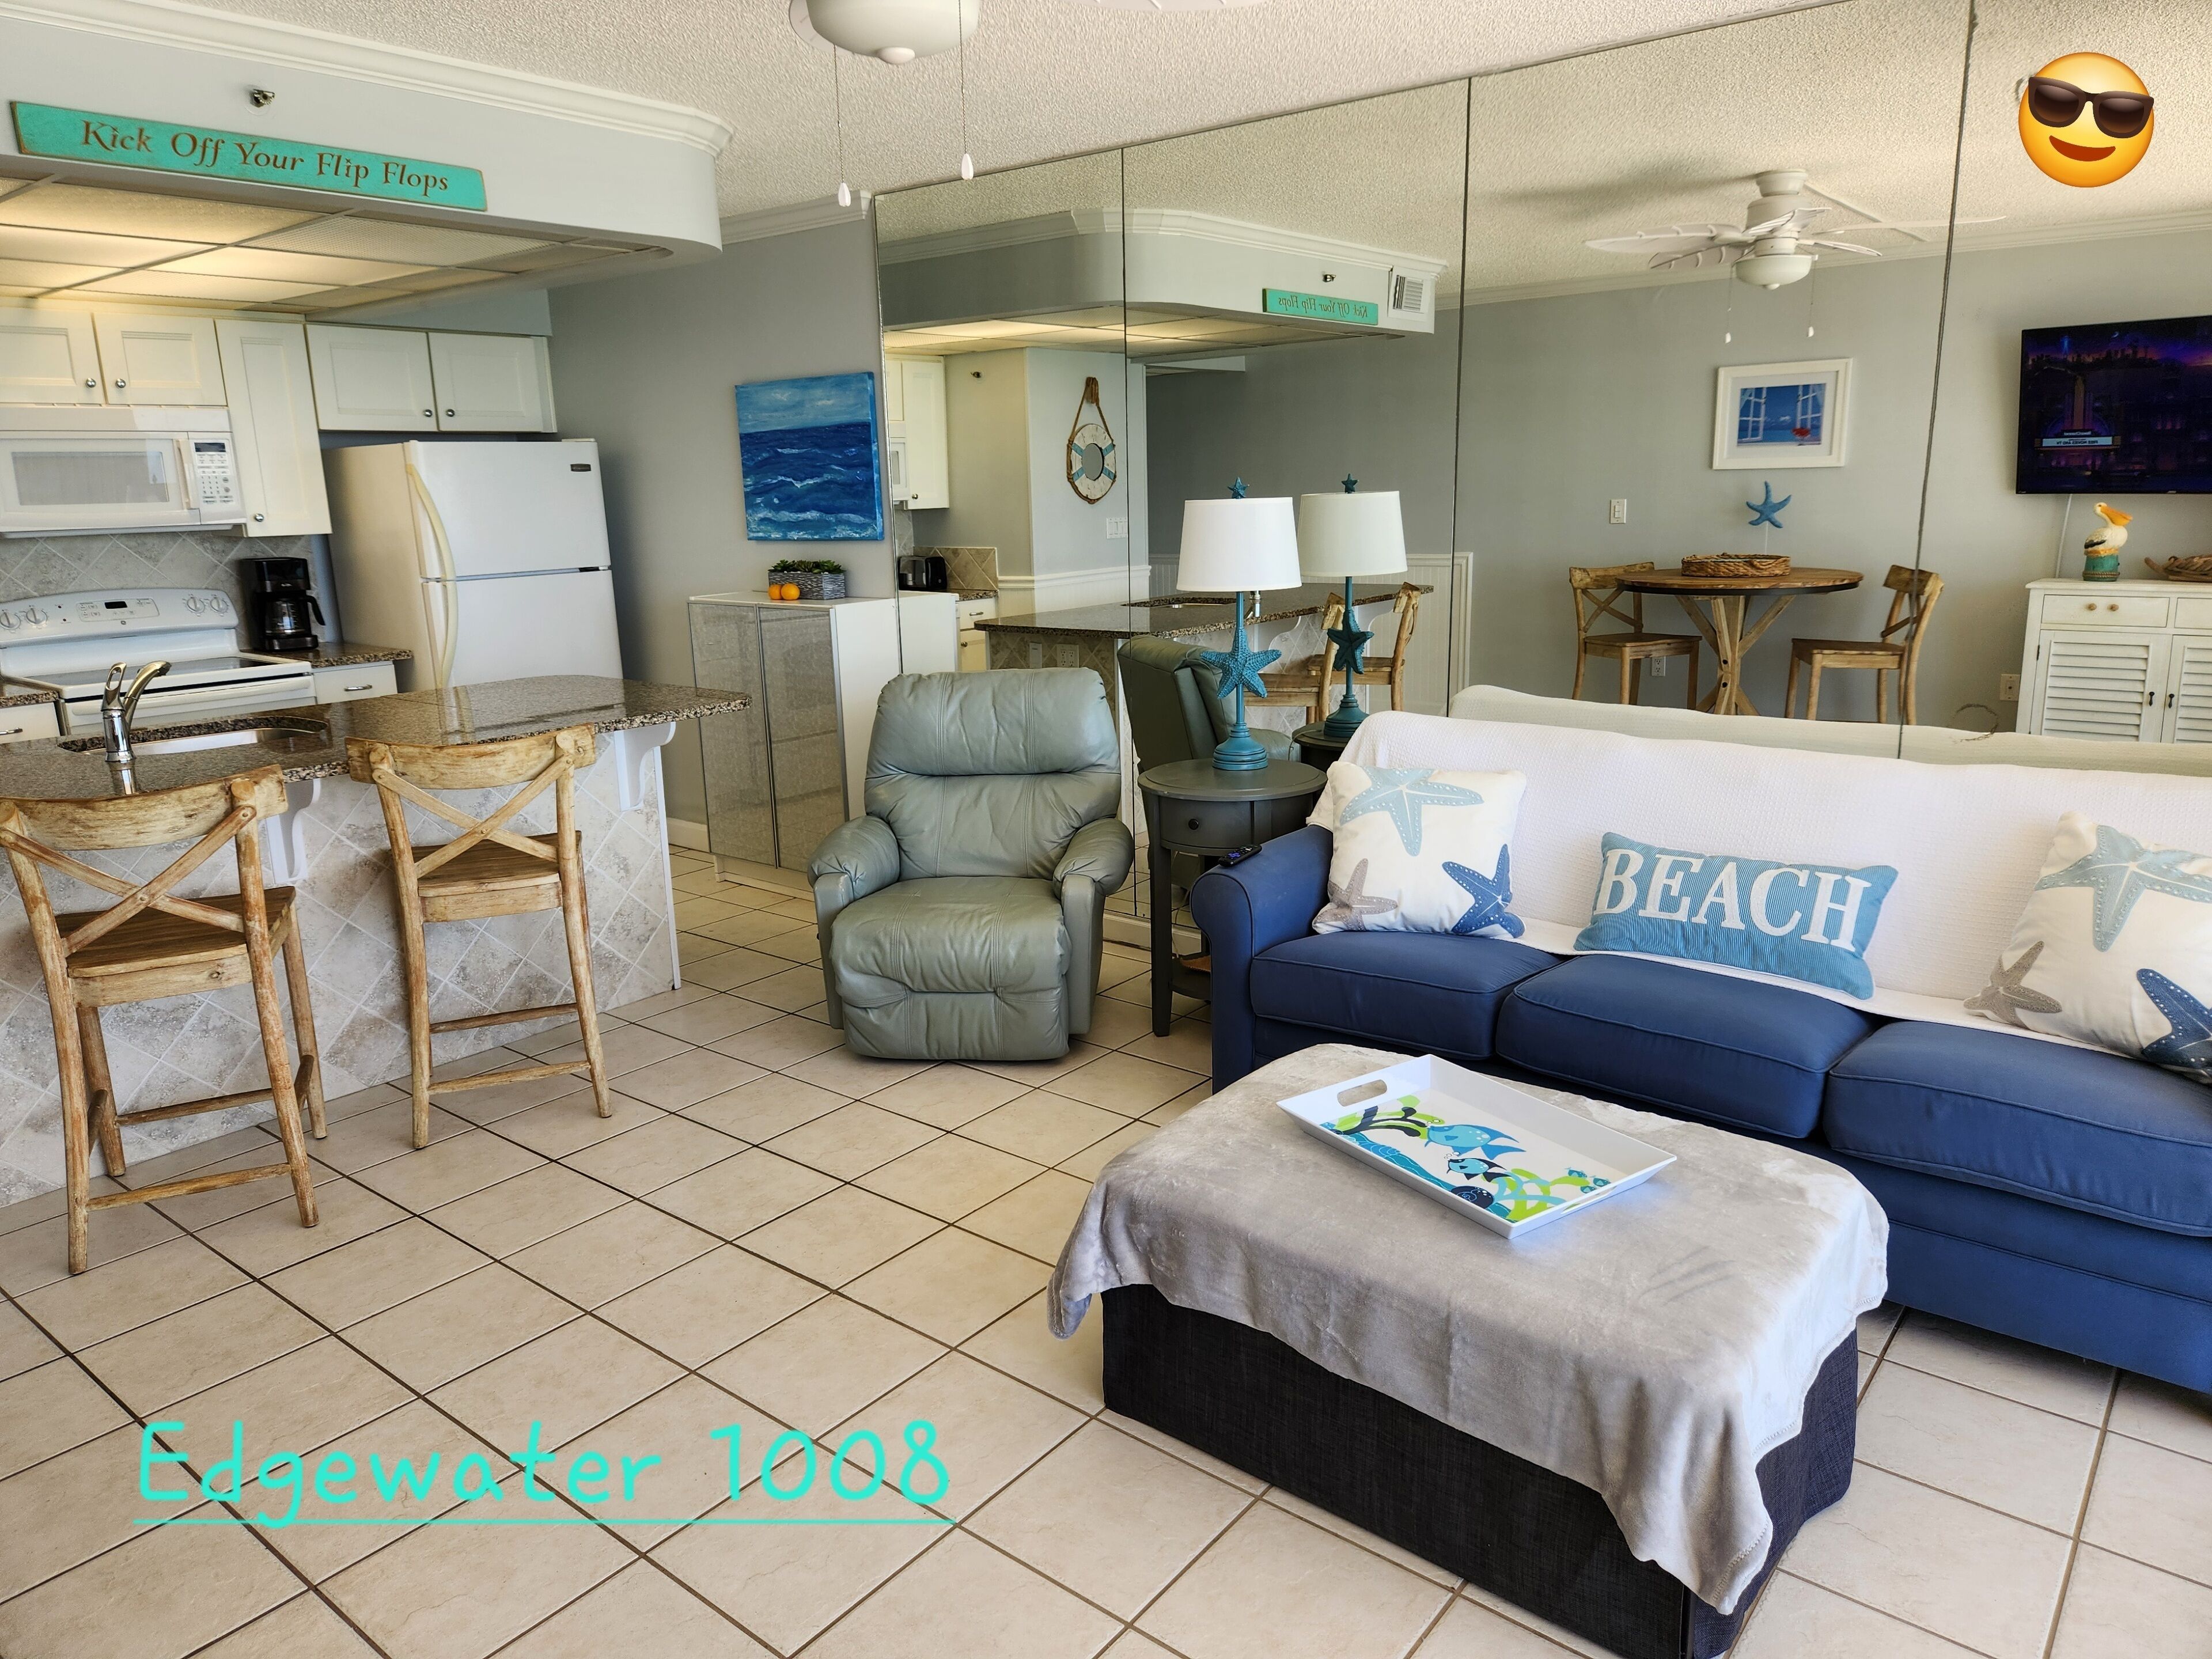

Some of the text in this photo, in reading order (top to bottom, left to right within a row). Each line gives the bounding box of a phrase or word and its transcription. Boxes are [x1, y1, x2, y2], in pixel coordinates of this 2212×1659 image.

[81, 120, 449, 197] Kick Off Your Flip Flops
[1593, 849, 1872, 952] BEACH
